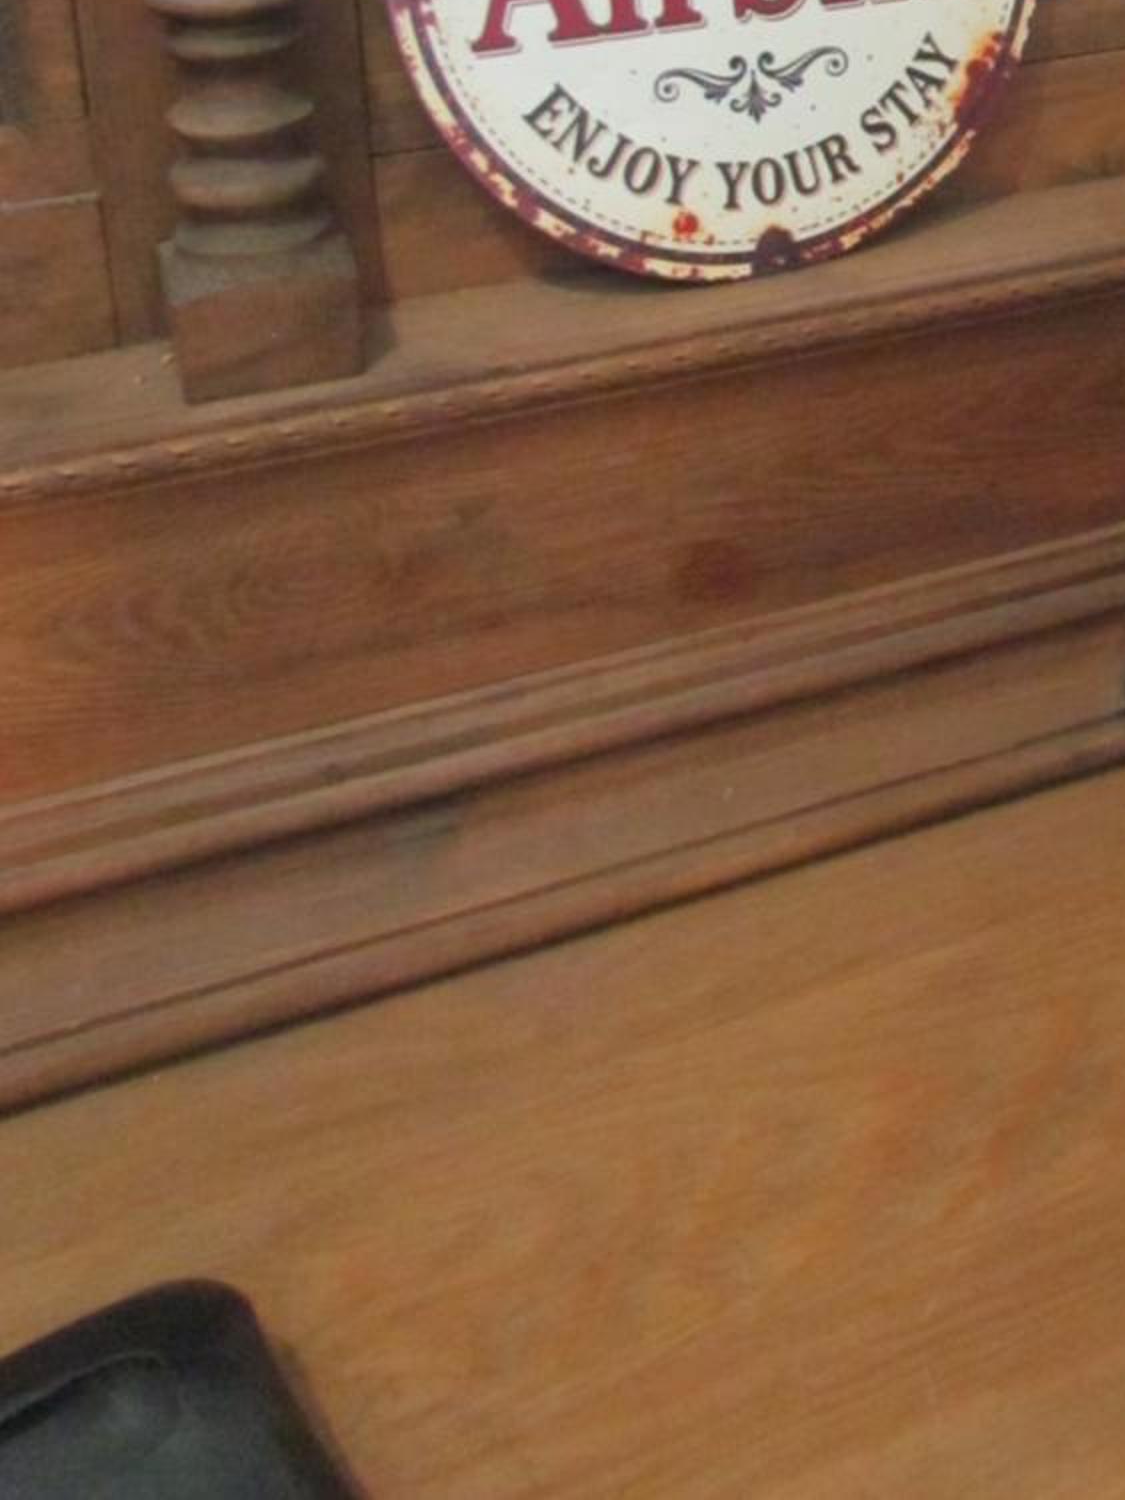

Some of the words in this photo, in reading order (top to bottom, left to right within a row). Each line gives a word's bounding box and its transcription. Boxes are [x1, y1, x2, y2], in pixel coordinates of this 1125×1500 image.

[522, 83, 700, 206] ENJOY
[715, 133, 861, 211] YOUR
[859, 31, 959, 154] STAY
